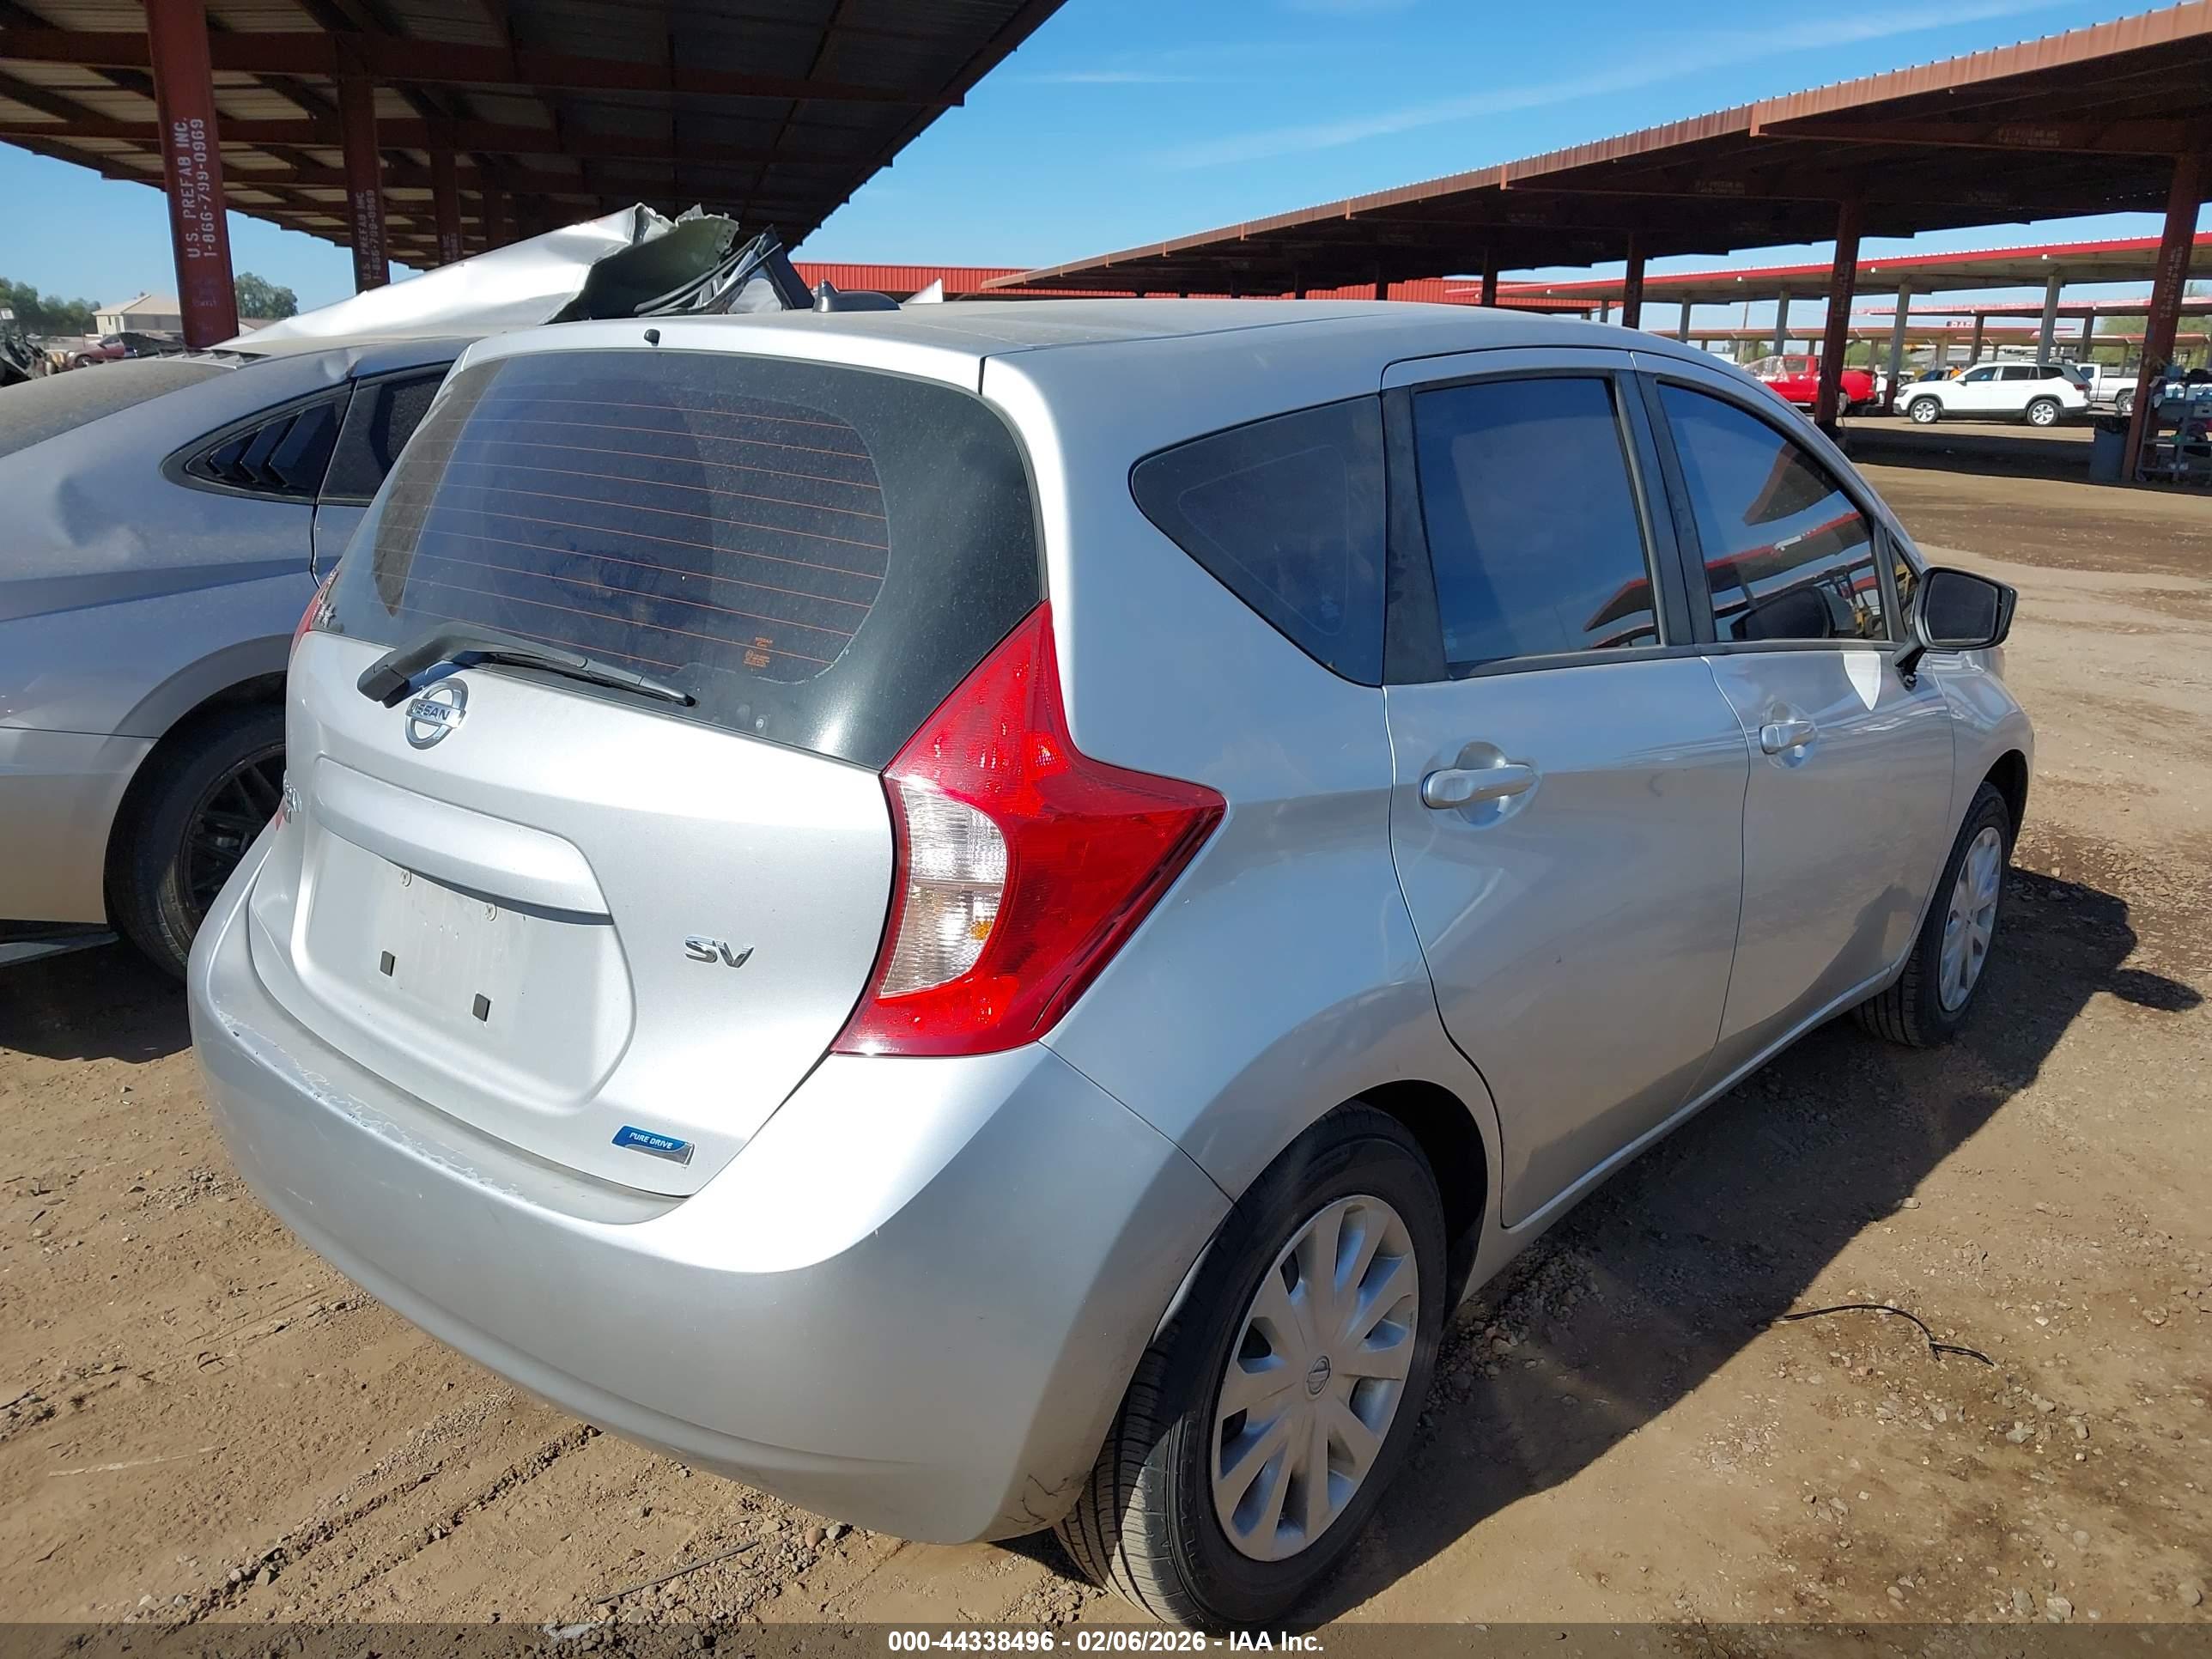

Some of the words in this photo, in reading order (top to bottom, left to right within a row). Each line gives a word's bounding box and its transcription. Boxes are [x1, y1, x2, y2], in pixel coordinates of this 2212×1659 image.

[173, 117, 190, 148] INC.
[177, 155, 197, 219] PREFAB
[190, 118, 218, 257] 1-866-799-0969
[185, 228, 201, 258] U.S.
[684, 935, 755, 969] SV
[629, 1132, 650, 1143] PURE
[649, 1138, 673, 1149] DRIVE
